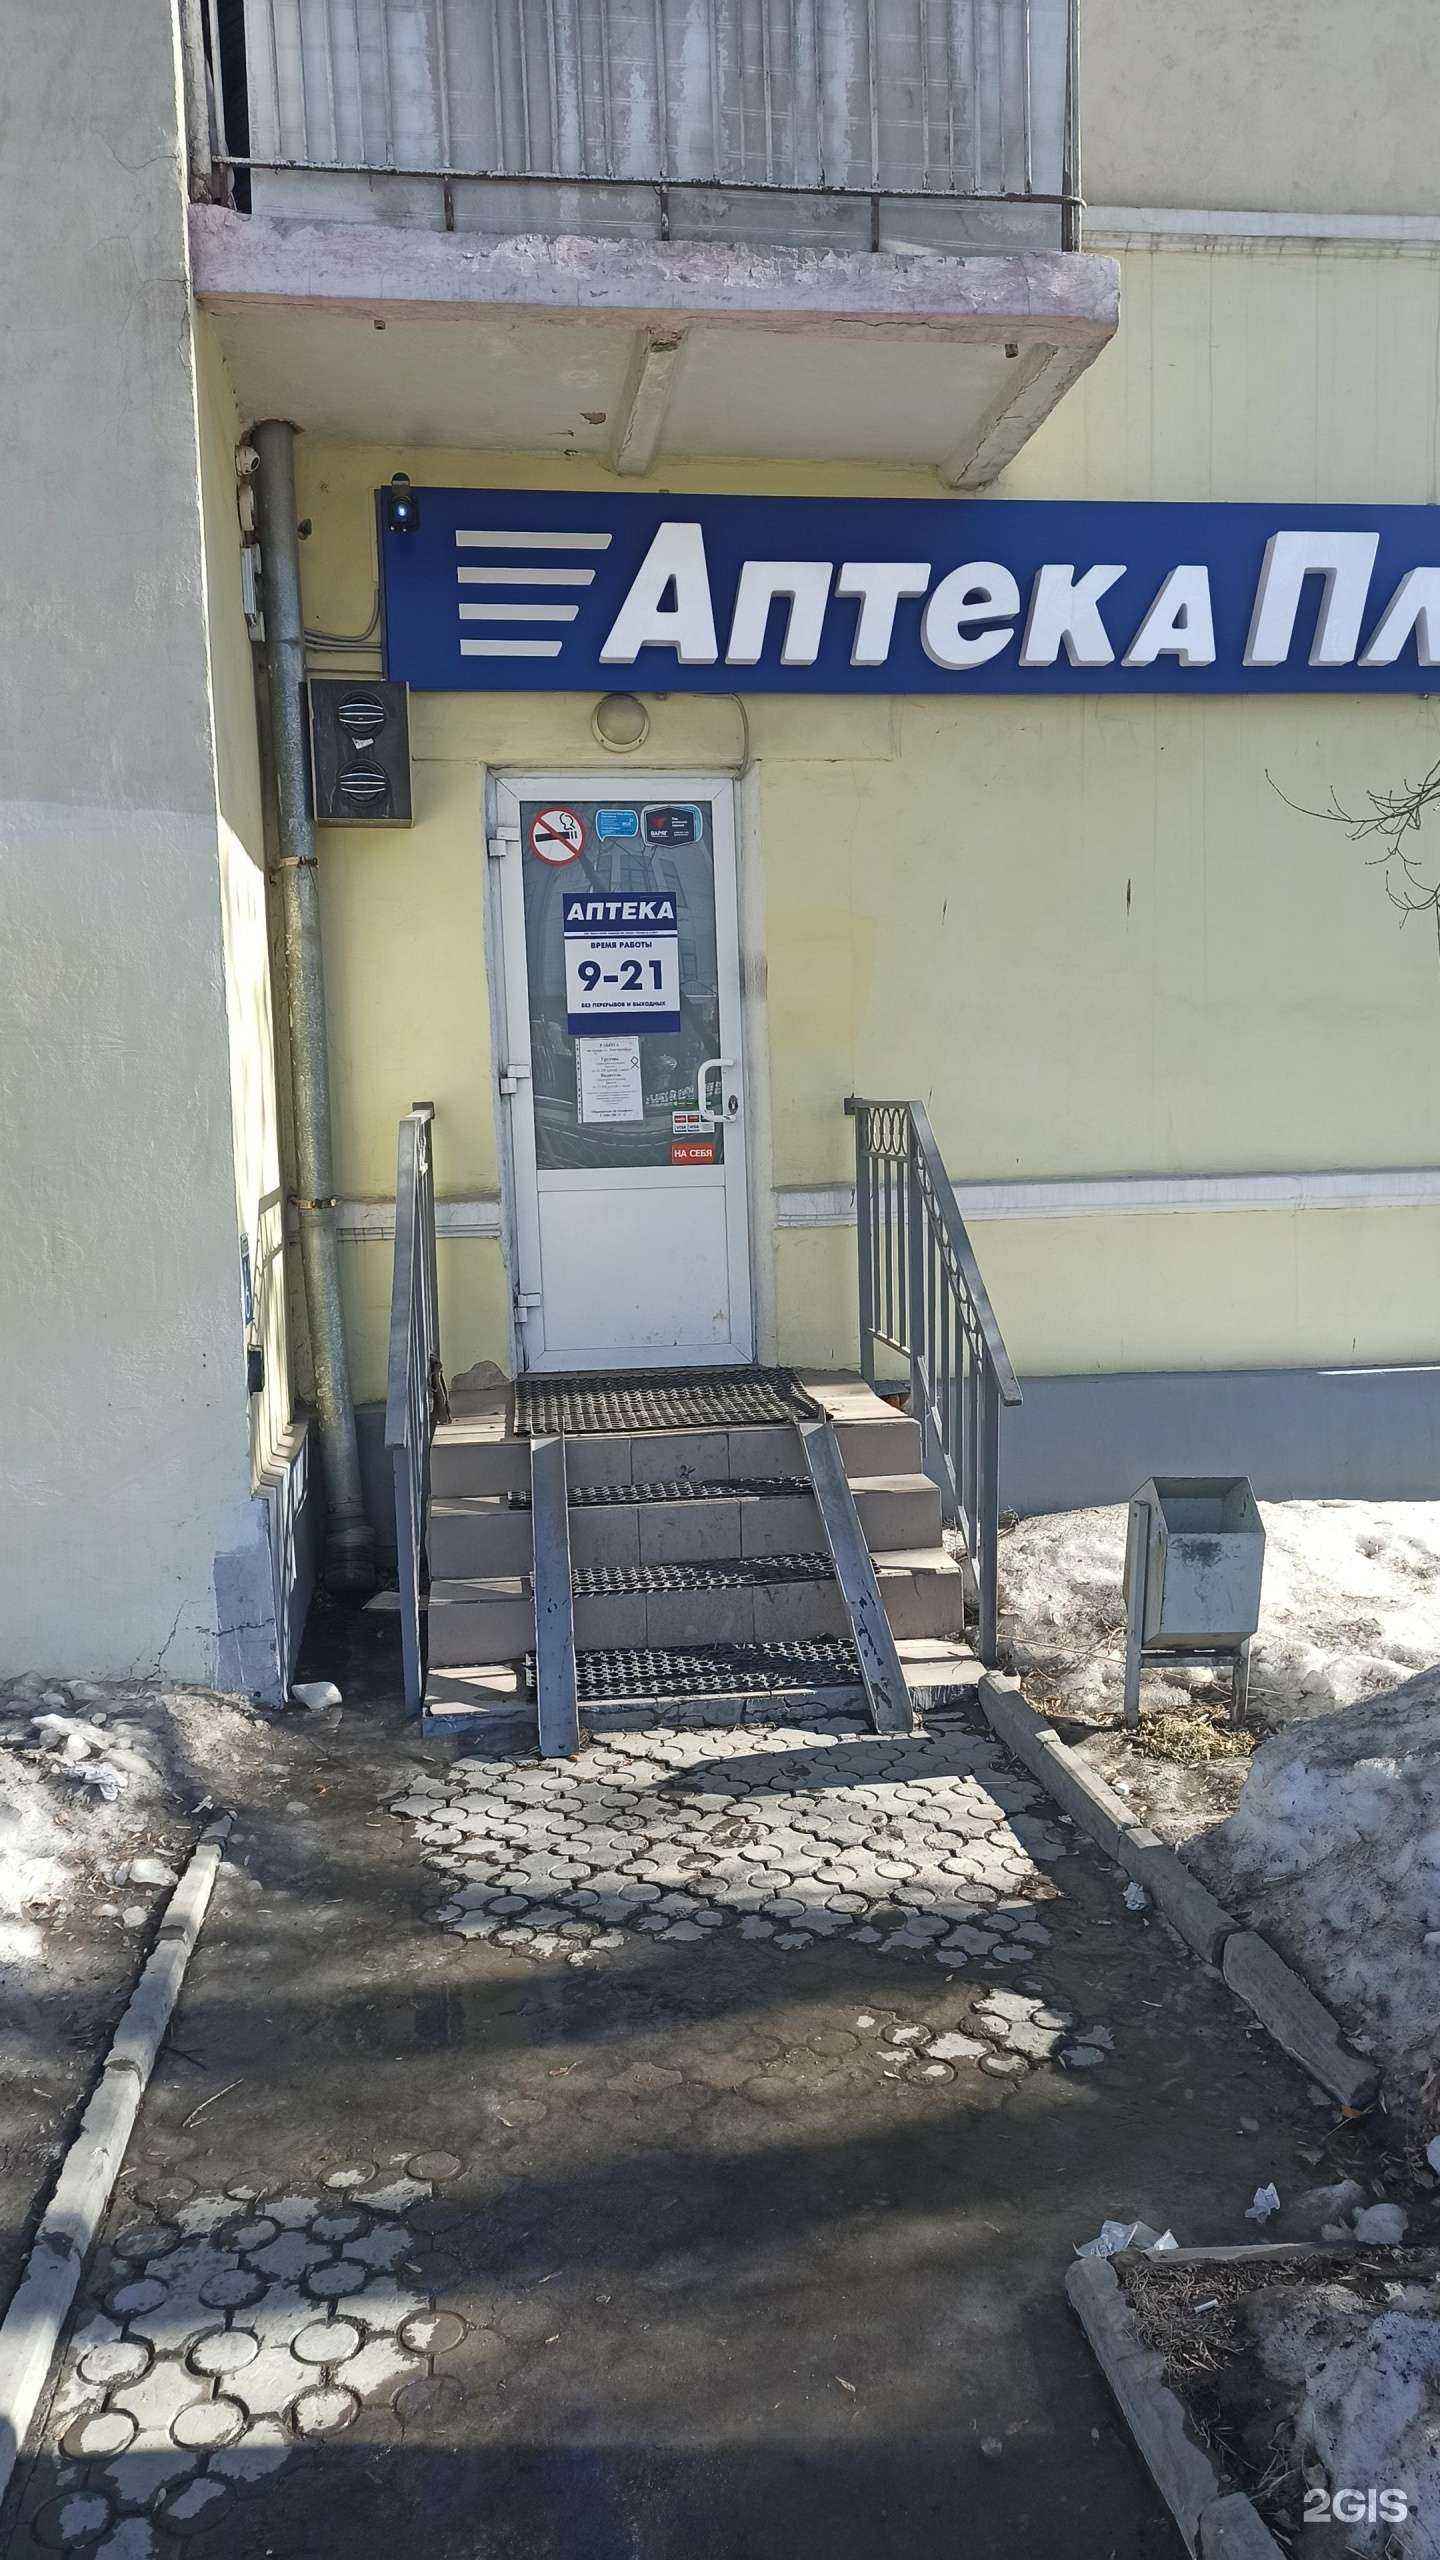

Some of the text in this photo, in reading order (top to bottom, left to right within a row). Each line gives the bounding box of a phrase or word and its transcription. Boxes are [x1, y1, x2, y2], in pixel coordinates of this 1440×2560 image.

[599, 521, 1217, 671] Аптека
[566, 901, 675, 921] АПТЕКА
[590, 941, 653, 949] ВРЕМЯ РАБОТЫ
[577, 959, 663, 992] 9-21
[674, 1149, 713, 1158] НА СЕБЯ
